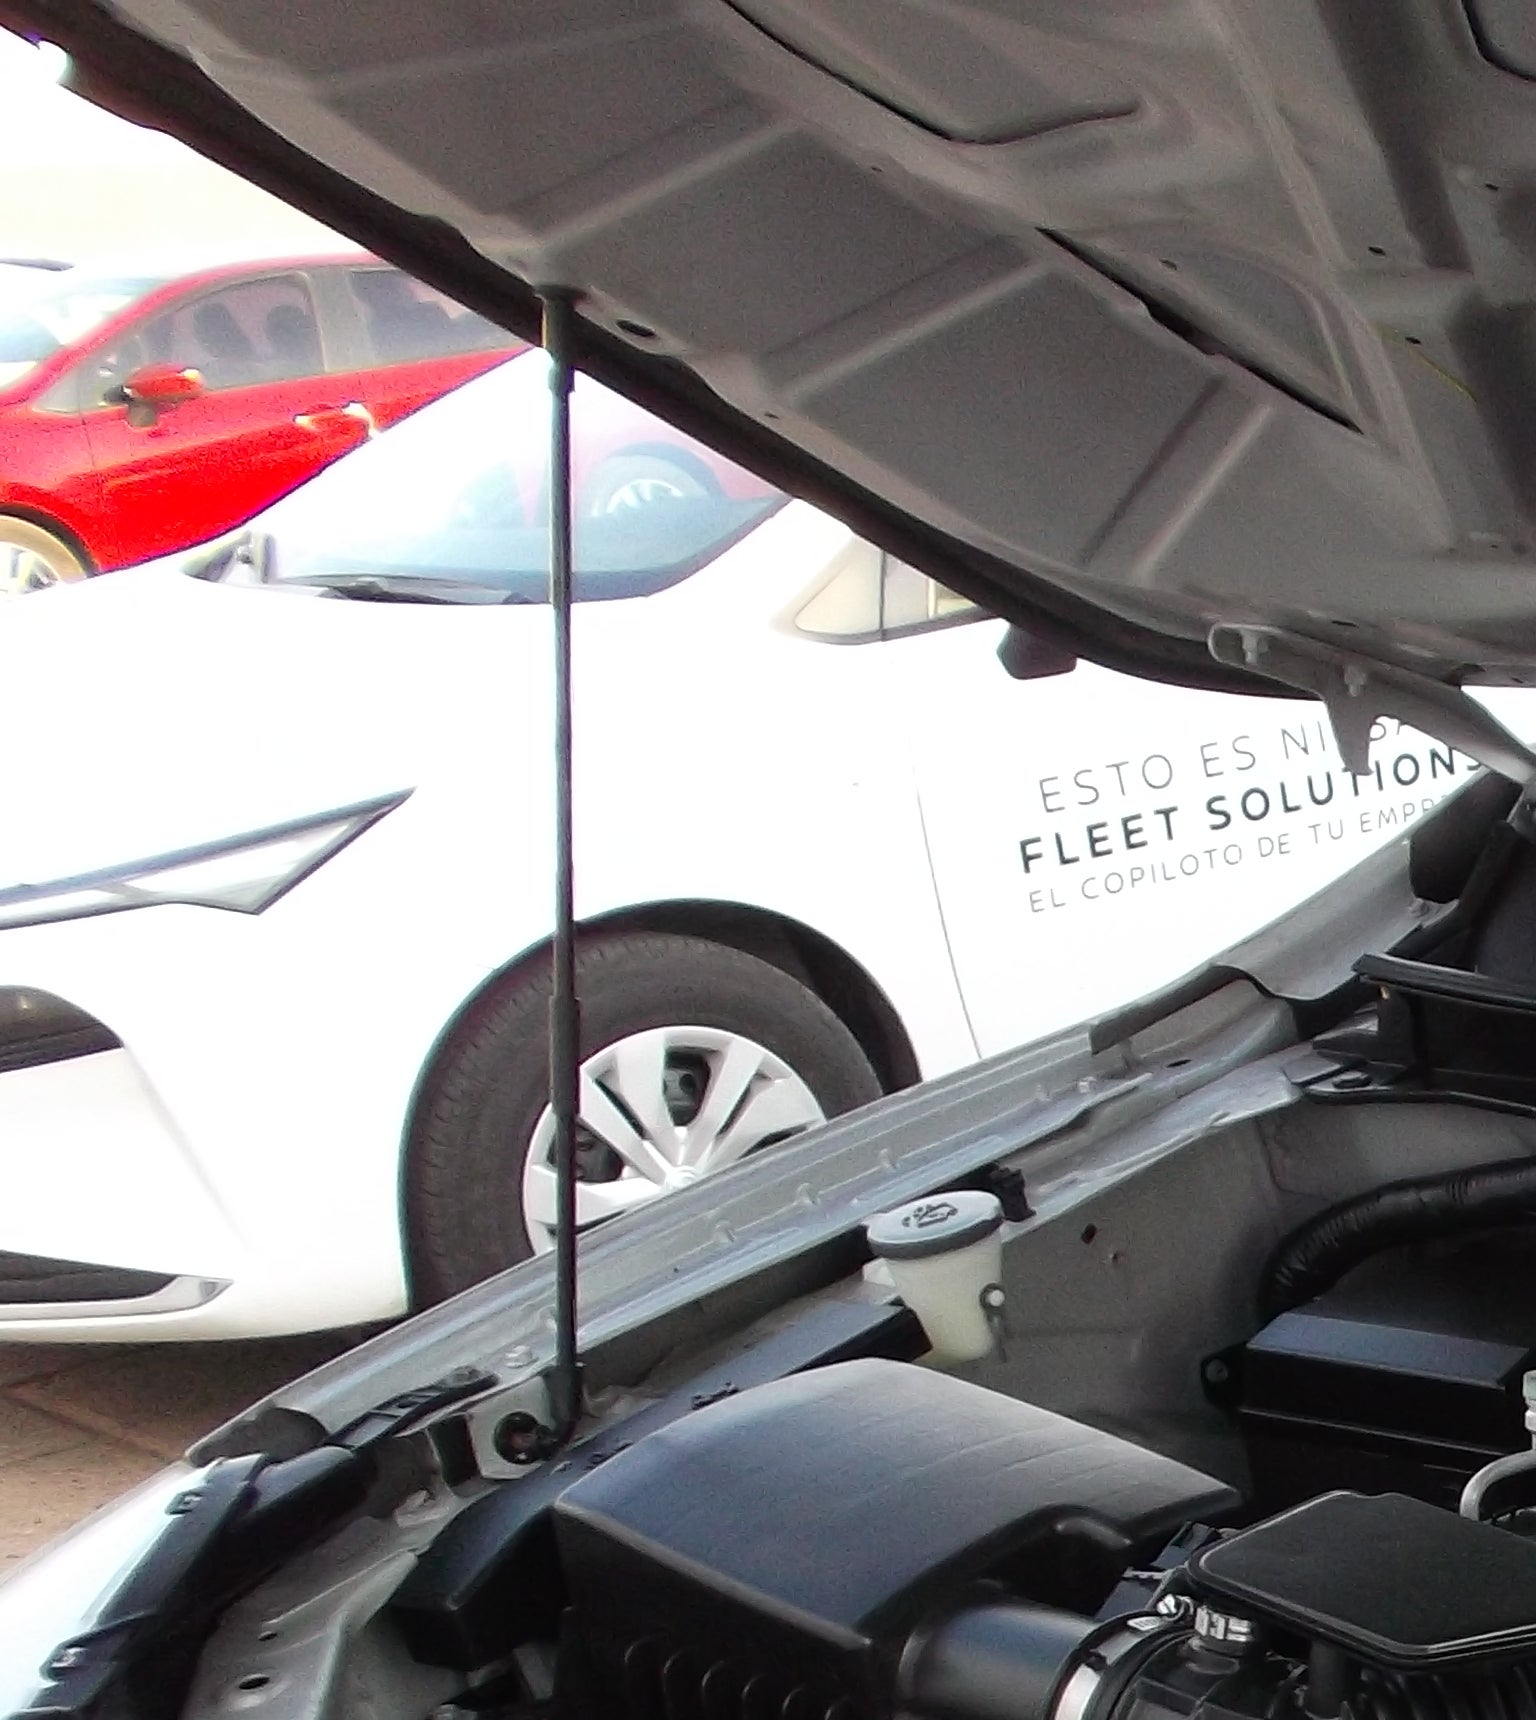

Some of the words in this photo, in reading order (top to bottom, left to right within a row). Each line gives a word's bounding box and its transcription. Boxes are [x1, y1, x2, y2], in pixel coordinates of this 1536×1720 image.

[1019, 805, 1179, 874] FLEET
[1205, 747, 1483, 831] SOLUTION
[1039, 753, 1173, 813] ESTO
[1200, 735, 1256, 778] ES
[1029, 888, 1067, 913] EL
[1081, 843, 1243, 900] COPILOTO
[1257, 833, 1290, 858] DE
[1308, 818, 1344, 845] TU
